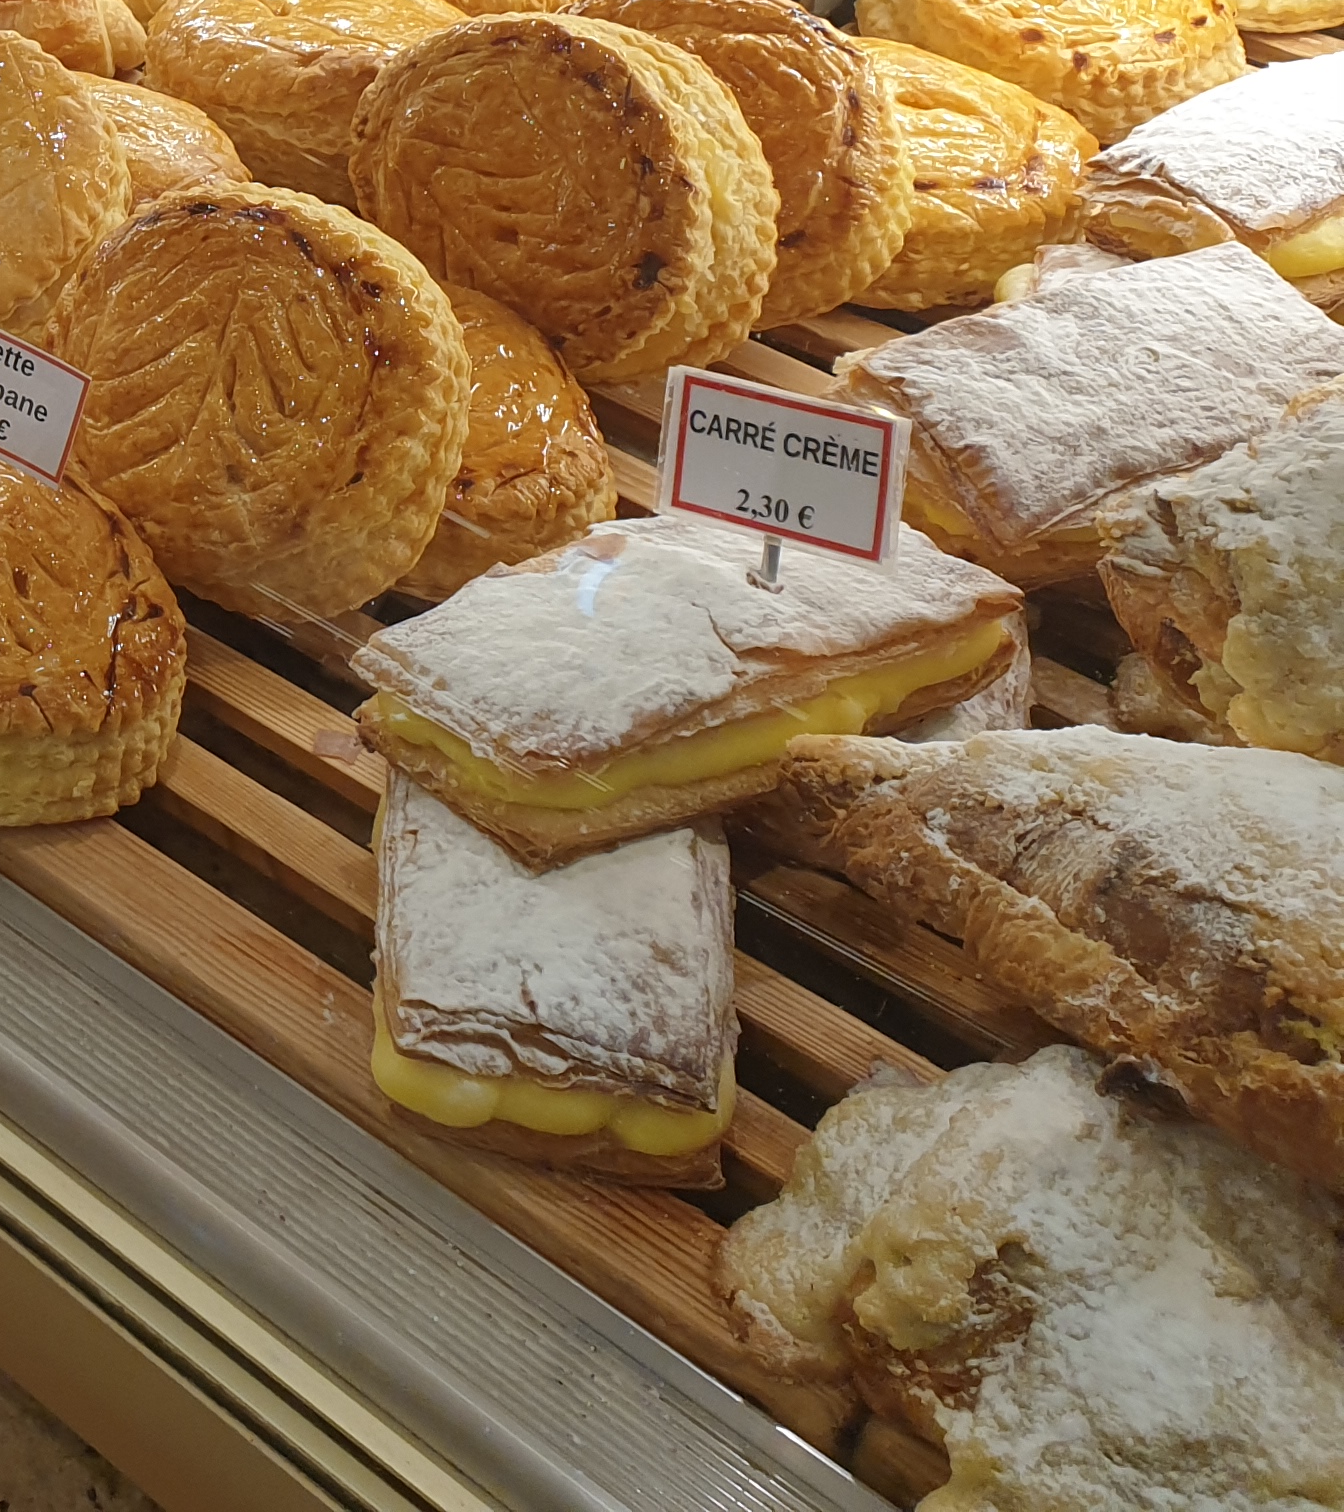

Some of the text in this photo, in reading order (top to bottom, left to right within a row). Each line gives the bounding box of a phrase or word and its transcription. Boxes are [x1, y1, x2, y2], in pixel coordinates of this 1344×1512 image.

[690, 409, 879, 478] CARRÉ CRÈME
[735, 489, 815, 529] 2,30 €
